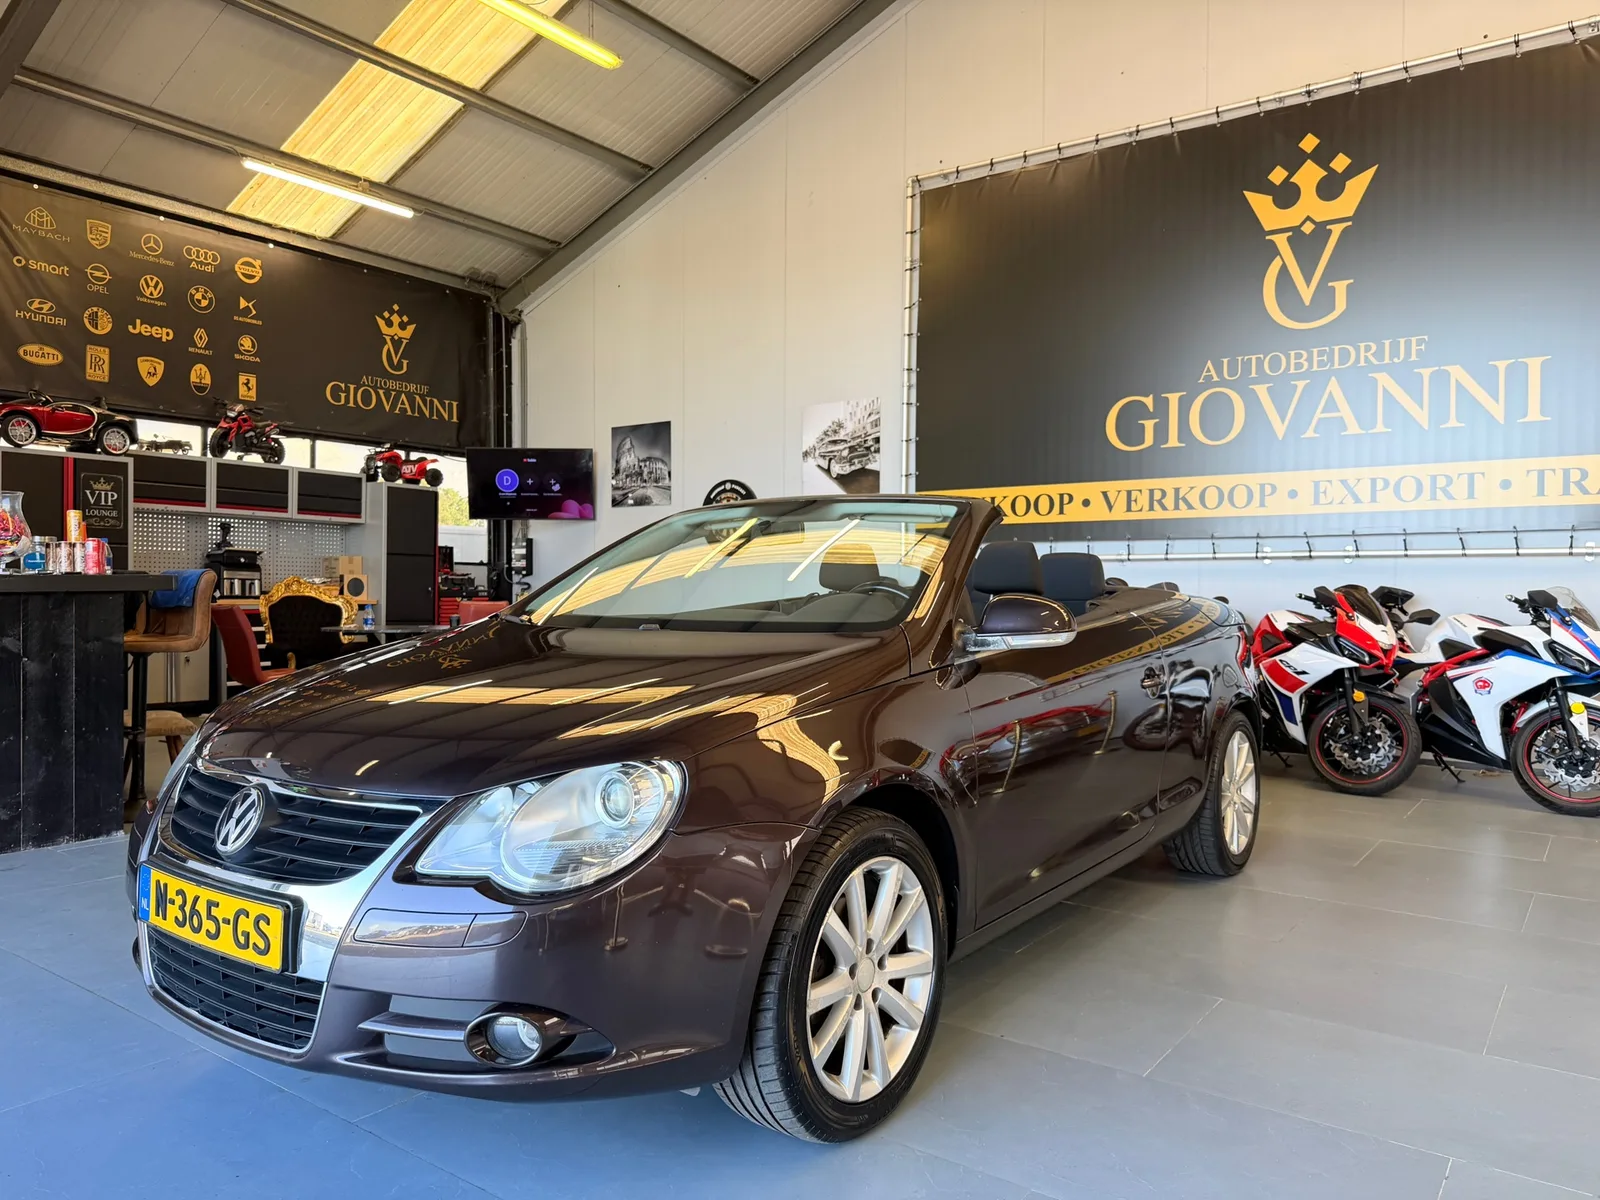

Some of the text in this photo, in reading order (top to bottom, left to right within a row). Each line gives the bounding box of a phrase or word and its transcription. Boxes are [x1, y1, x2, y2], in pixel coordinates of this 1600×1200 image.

[12, 223, 70, 242] MAYBACH
[128, 250, 175, 267] Mercedes-Benz
[189, 261, 215, 273] Audi
[28, 259, 70, 277] smart
[237, 266, 260, 275] VOLVO
[86, 283, 110, 295] OPEL
[136, 295, 167, 307] Volkswagen
[15, 309, 67, 327] HYUNDAI
[127, 318, 175, 342] Jeep
[22, 349, 59, 362] BUGATTI
[188, 346, 214, 356] RENAULT
[1198, 335, 1429, 383] AUTOBEDRIJF
[360, 375, 430, 395] AUTOBEDRIJF
[325, 381, 460, 423] GIOVANNI
[1105, 355, 1552, 452] GIOVANNI
[401, 463, 417, 475] ATV
[503, 475, 512, 486] D
[84, 489, 118, 506] VIP
[982, 466, 1600, 518] KOOP VERKOOP EXPORT TR
[85, 508, 119, 518] LOUNGE
[141, 896, 150, 911] NL
[154, 878, 271, 957] N-365-GS
